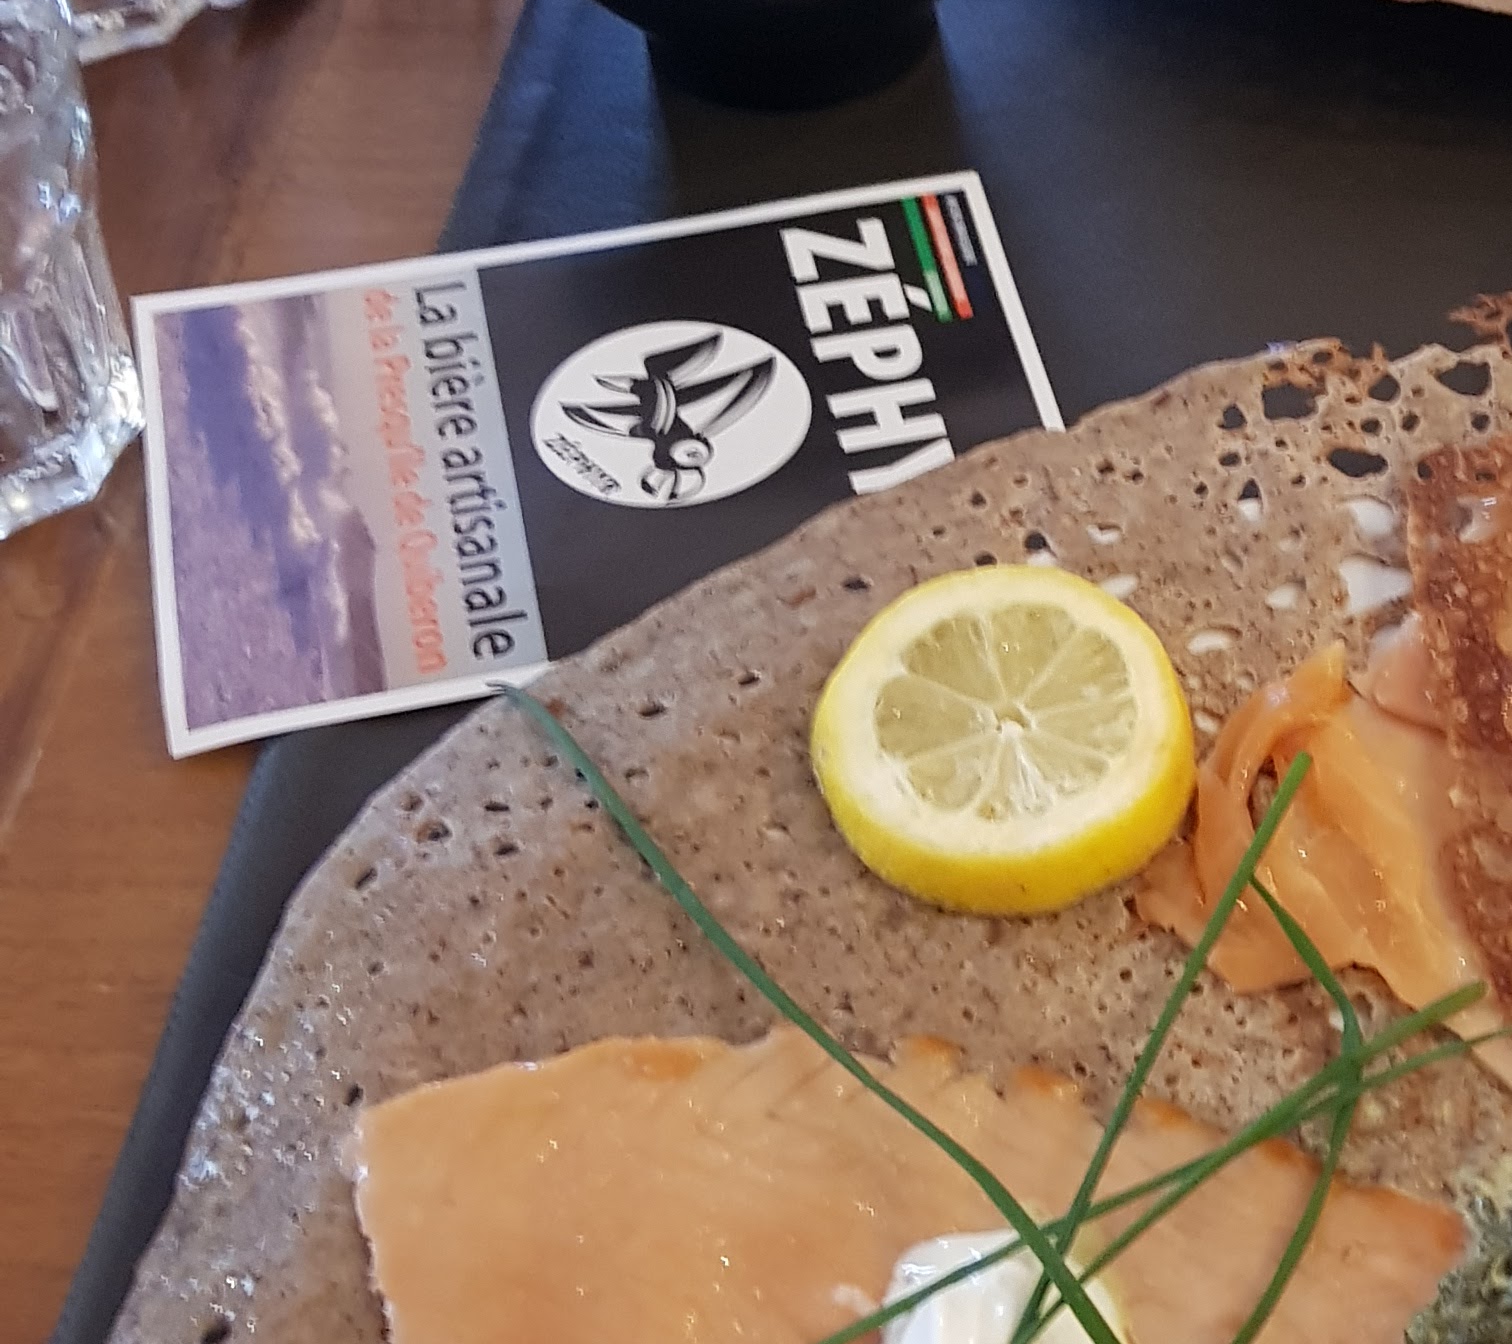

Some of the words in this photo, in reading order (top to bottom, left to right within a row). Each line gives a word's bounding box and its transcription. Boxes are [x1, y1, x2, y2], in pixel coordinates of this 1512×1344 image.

[414, 281, 467, 326] La
[424, 331, 485, 437] bière
[441, 447, 528, 660] artisanale
